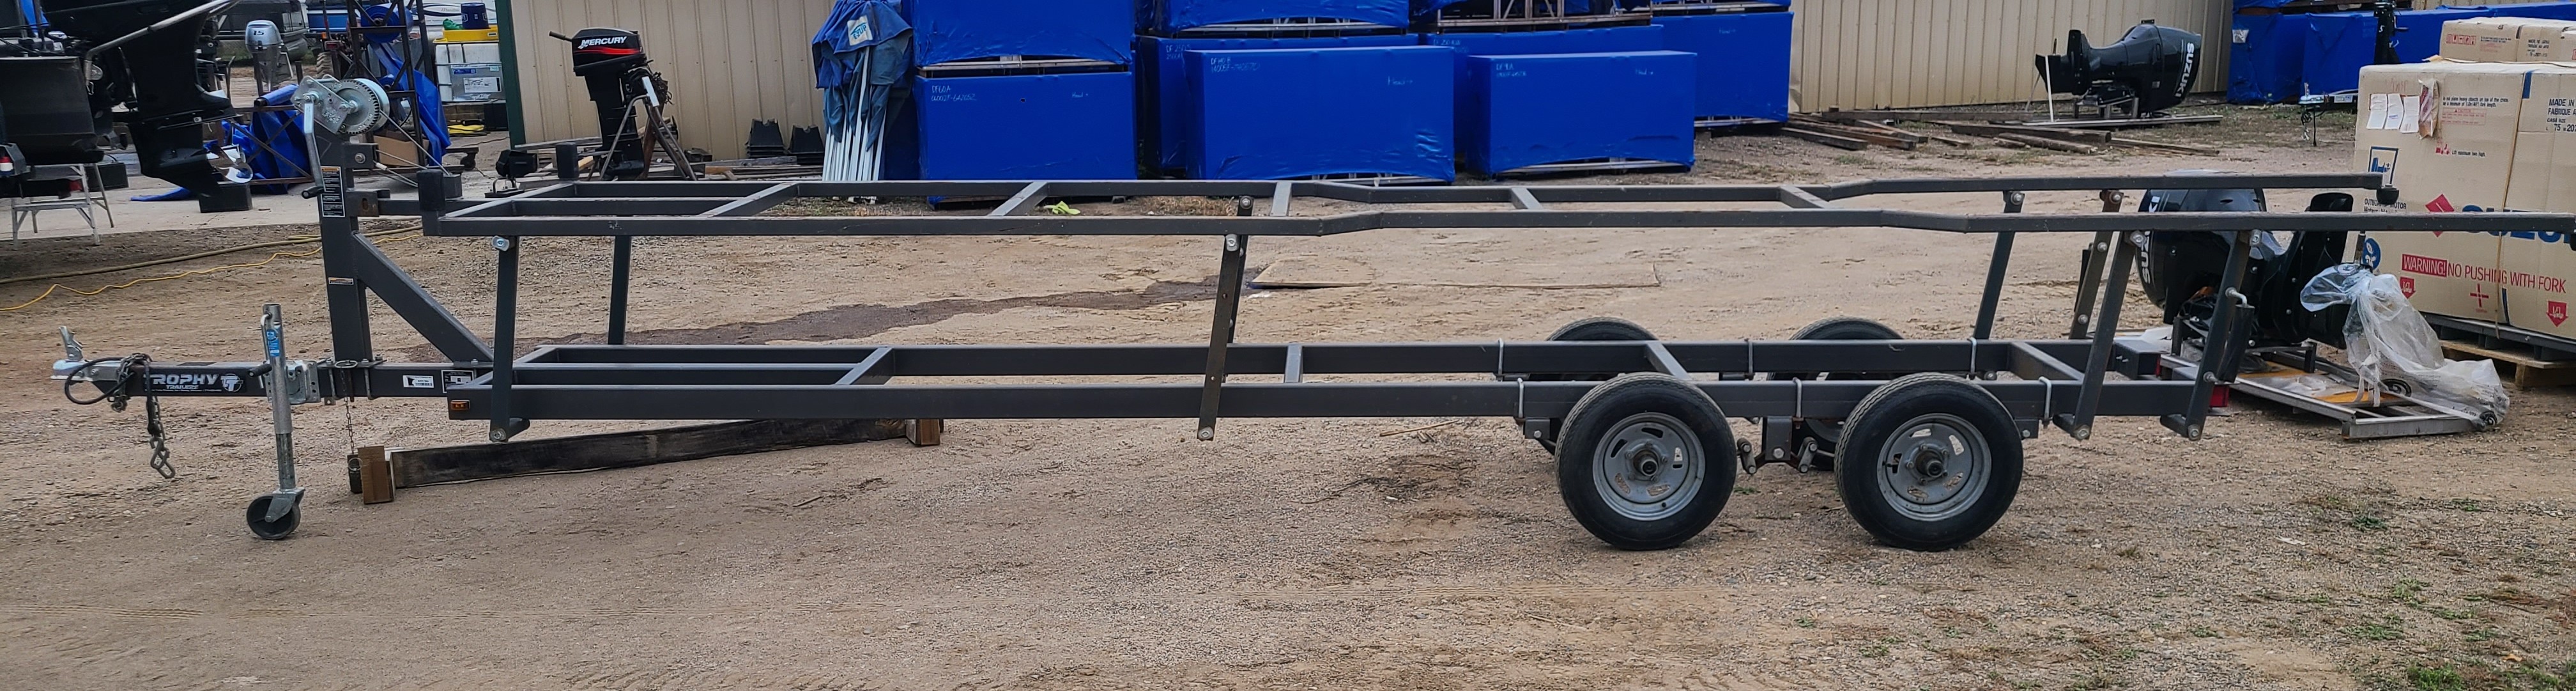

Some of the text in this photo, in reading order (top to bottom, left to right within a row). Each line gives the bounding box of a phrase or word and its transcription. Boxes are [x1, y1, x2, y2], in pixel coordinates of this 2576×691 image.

[578, 36, 627, 49] MERCURY
[2175, 42, 2195, 98] SUZUKI
[2403, 255, 2566, 294] WARNING! NO PUSHING WITH FORK
